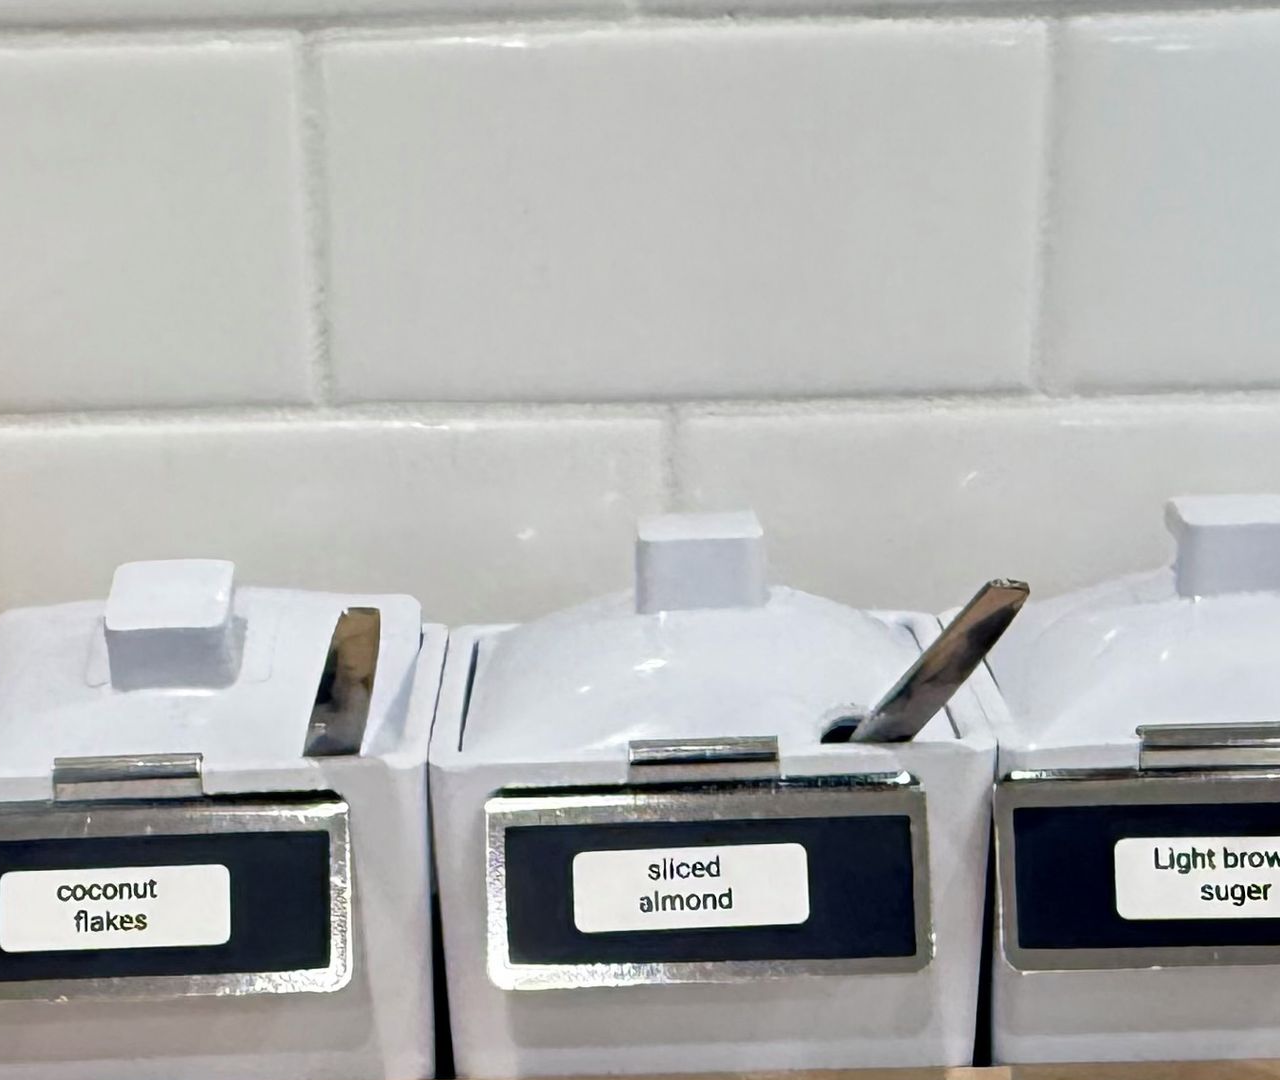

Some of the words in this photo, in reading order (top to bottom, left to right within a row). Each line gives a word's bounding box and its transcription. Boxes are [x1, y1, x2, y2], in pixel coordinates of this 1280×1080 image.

[647, 855, 721, 881] sliced
[1154, 846, 1218, 875] Light
[56, 878, 158, 902] coconut
[639, 887, 733, 913] almond
[1200, 883, 1273, 907] suger
[73, 909, 148, 933] flakes
